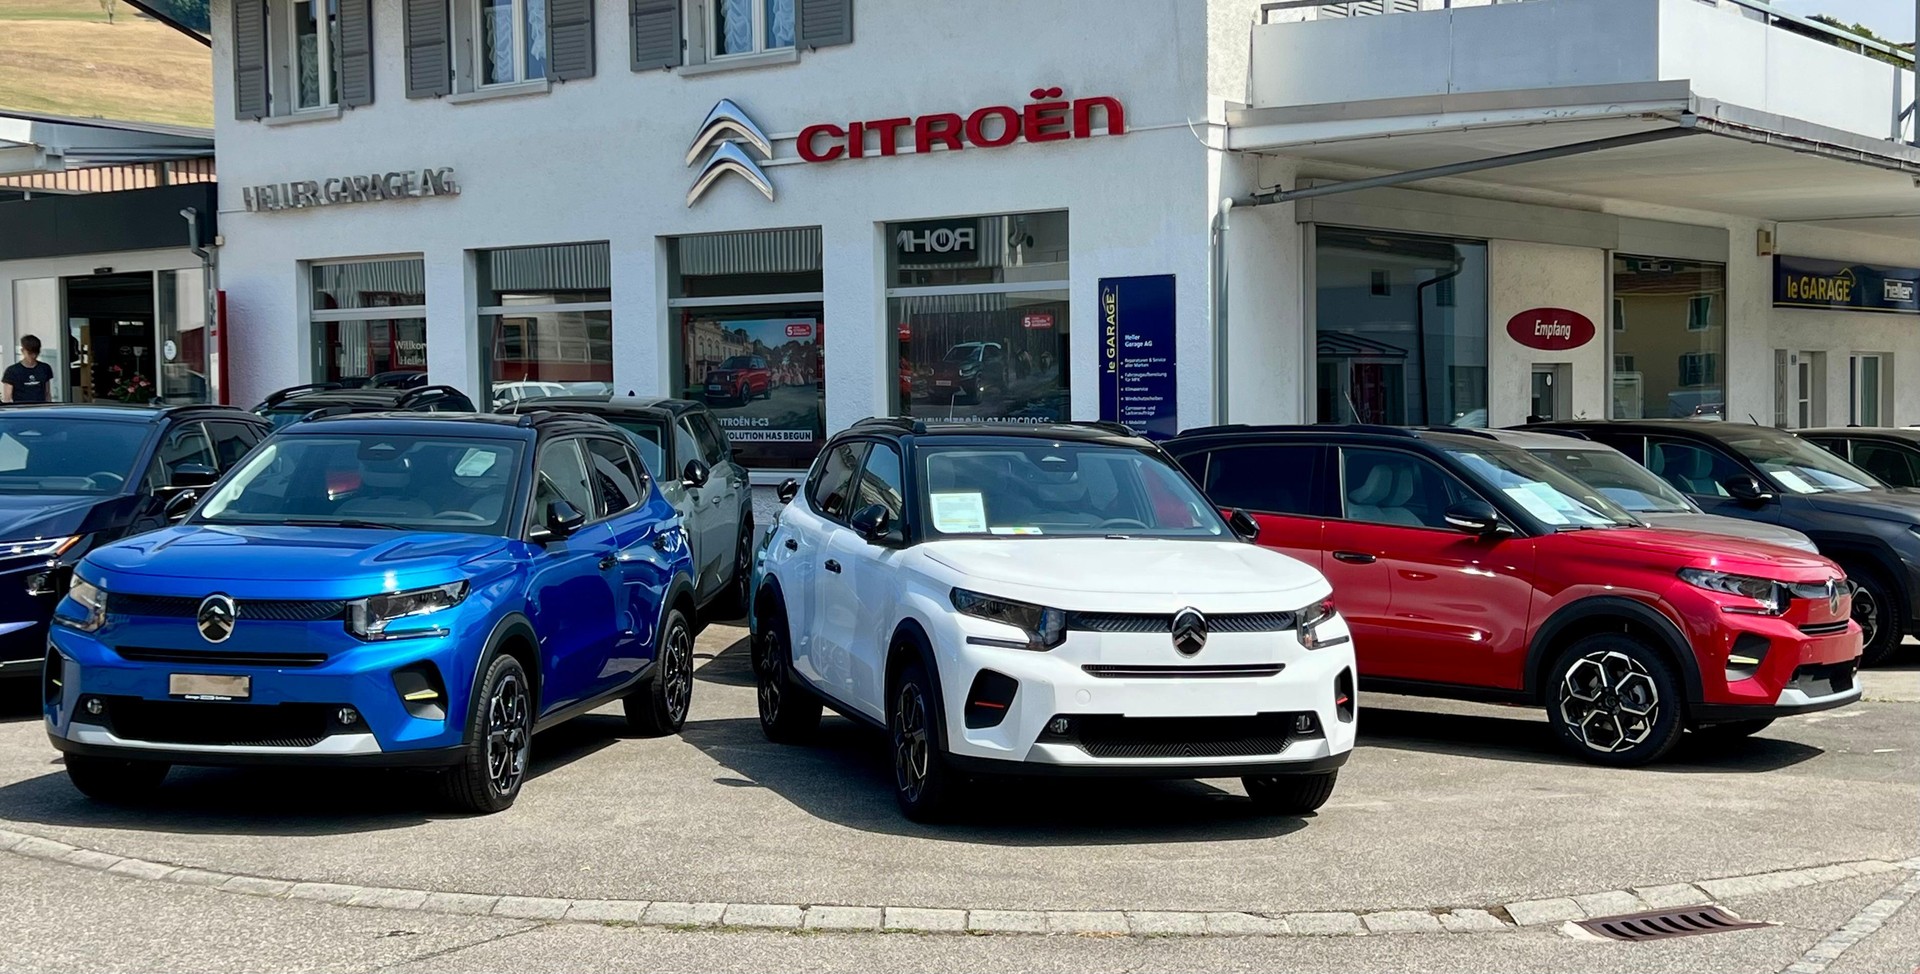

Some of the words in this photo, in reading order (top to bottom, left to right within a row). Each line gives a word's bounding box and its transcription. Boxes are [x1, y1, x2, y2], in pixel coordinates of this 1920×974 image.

[796, 86, 1125, 163] CITROËN
[242, 180, 323, 211] HELLER
[324, 170, 415, 205] GARAGE
[1787, 275, 1798, 298] le
[1800, 276, 1851, 301] GARAGE
[1883, 281, 1913, 300] heller
[1024, 316, 1031, 328] 5
[1106, 293, 1116, 359] GARAGE
[1534, 319, 1571, 341] Empfang
[1106, 361, 1116, 373] le
[765, 431, 784, 440] HAS
[784, 431, 811, 440] BEGUN
